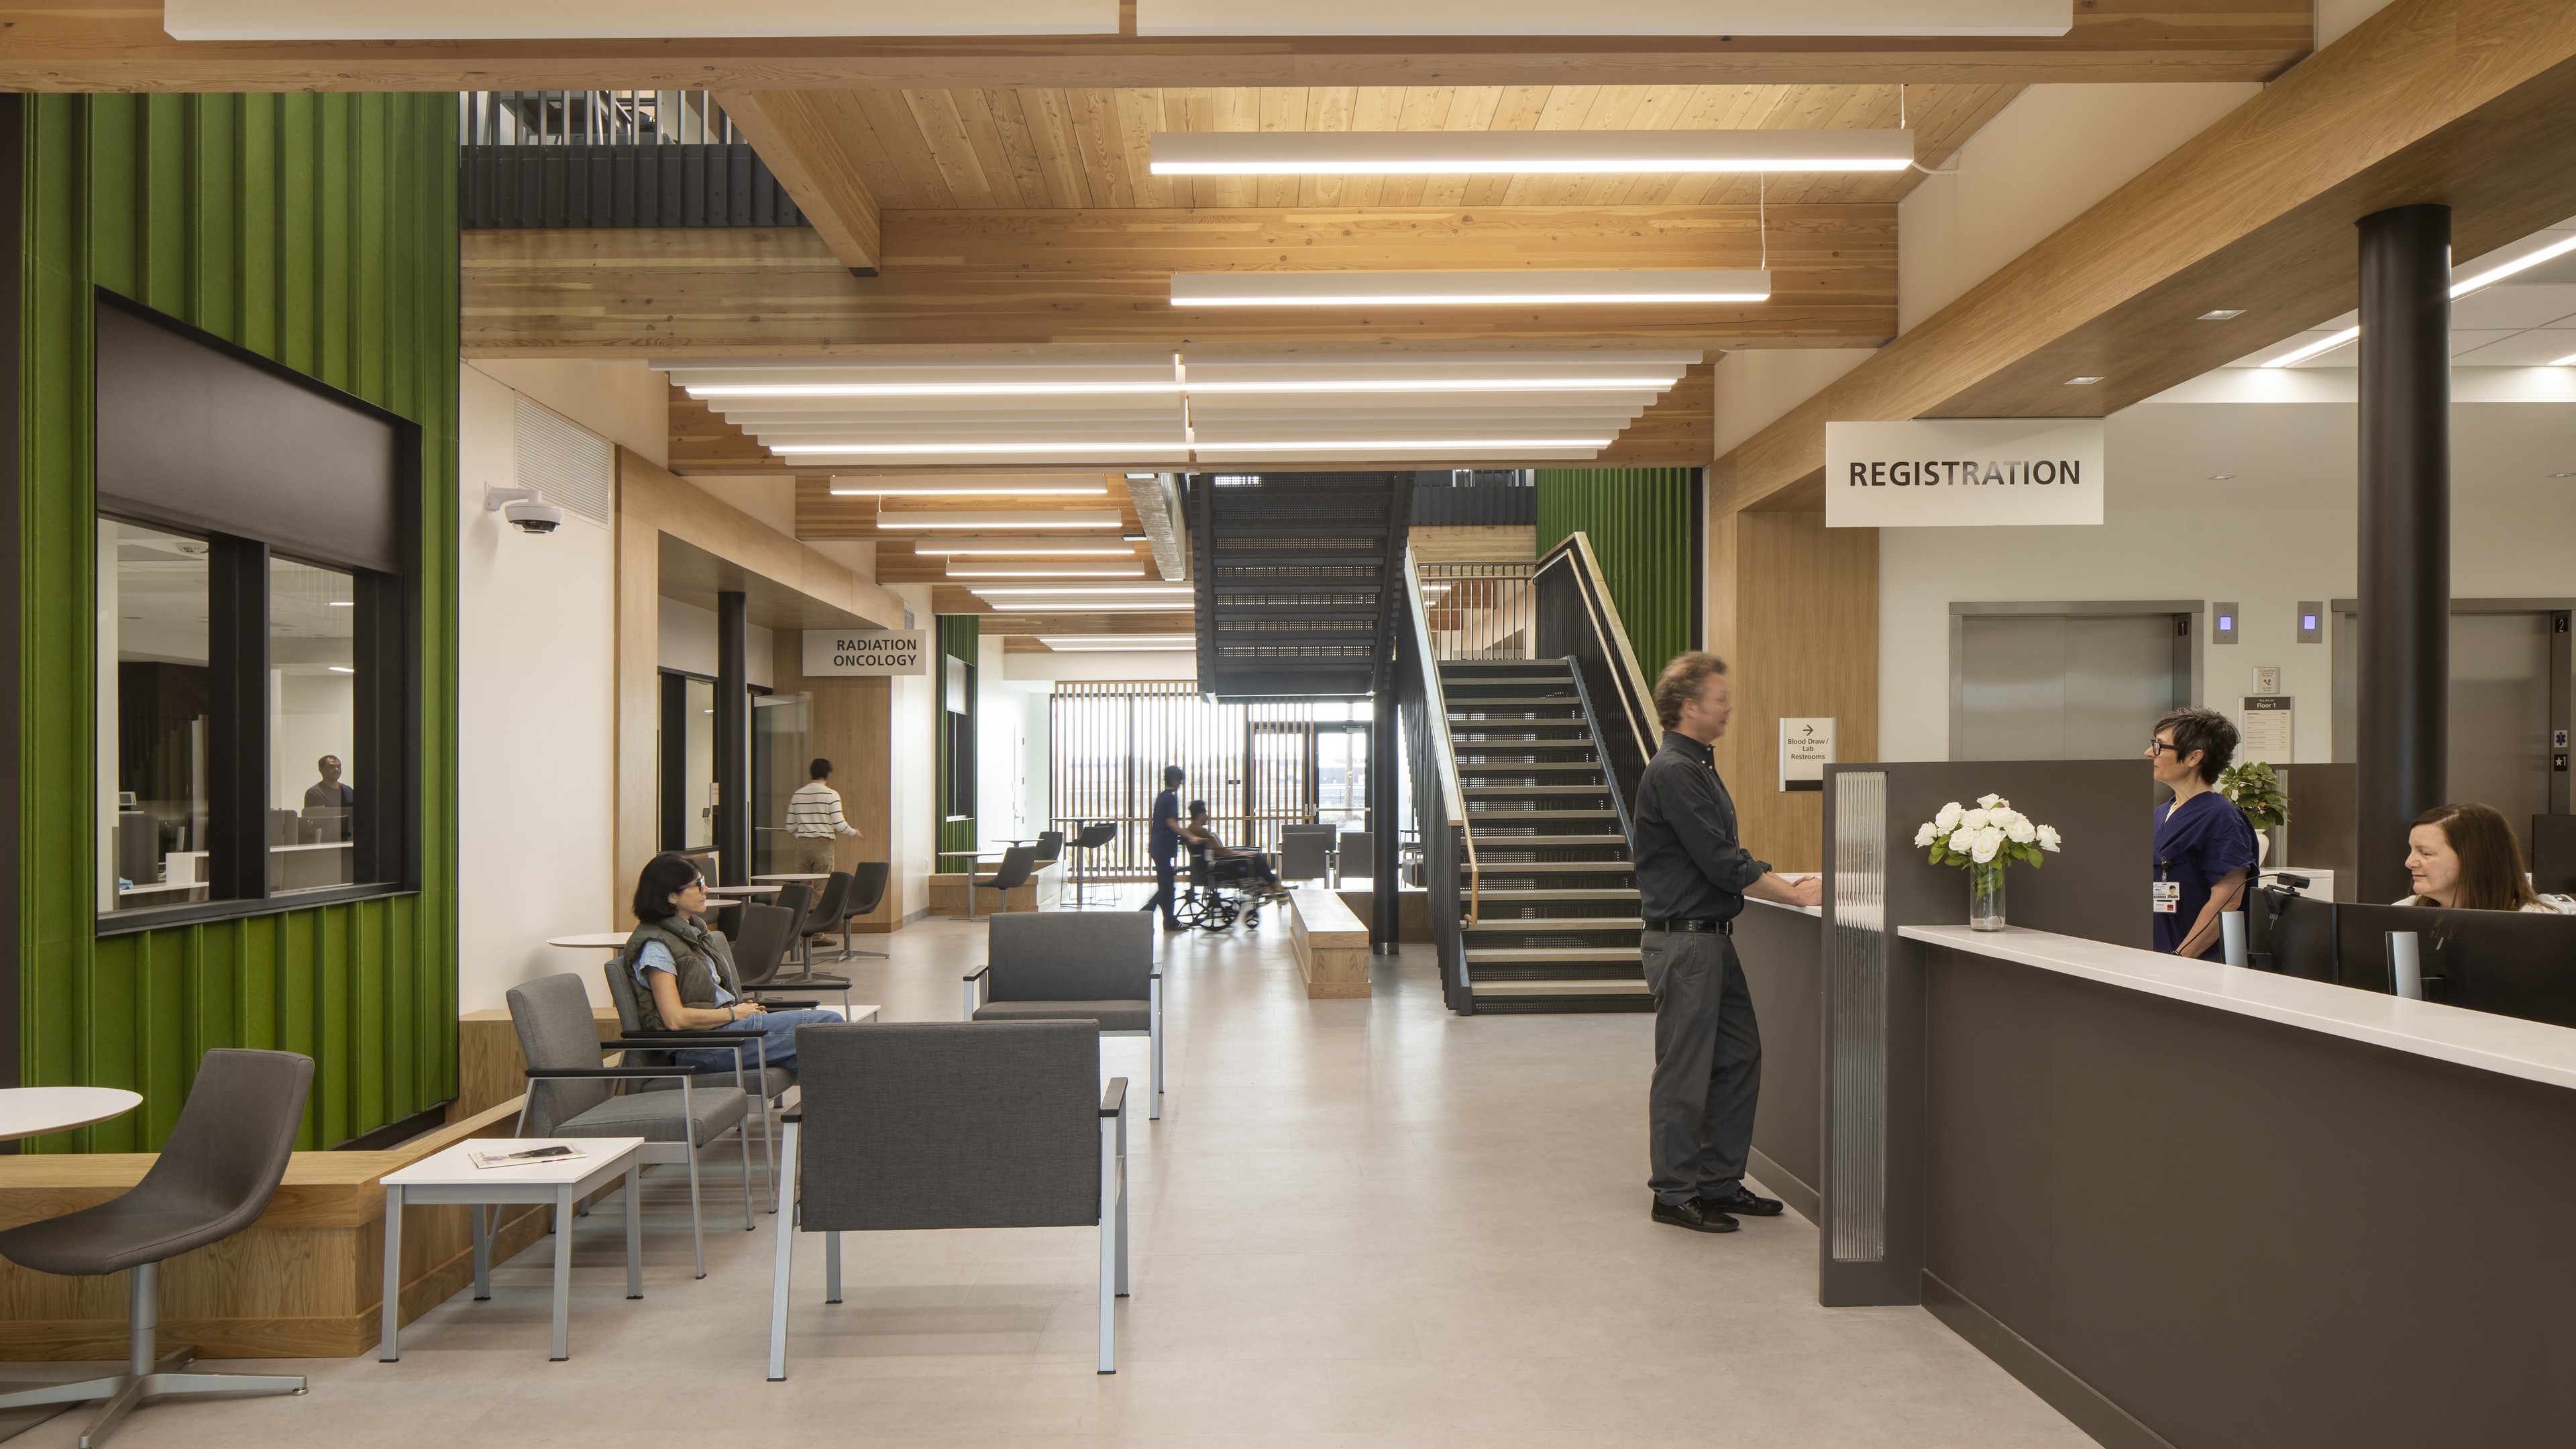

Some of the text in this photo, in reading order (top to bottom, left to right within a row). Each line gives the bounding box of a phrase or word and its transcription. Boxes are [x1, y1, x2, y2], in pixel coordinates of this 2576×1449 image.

[1849, 460, 2080, 486] REGISTRATION
[2181, 623, 2184, 635] 1
[2559, 619, 2564, 632] 2
[837, 639, 917, 651] RADIATION
[834, 655, 917, 666] ONCOLOGY
